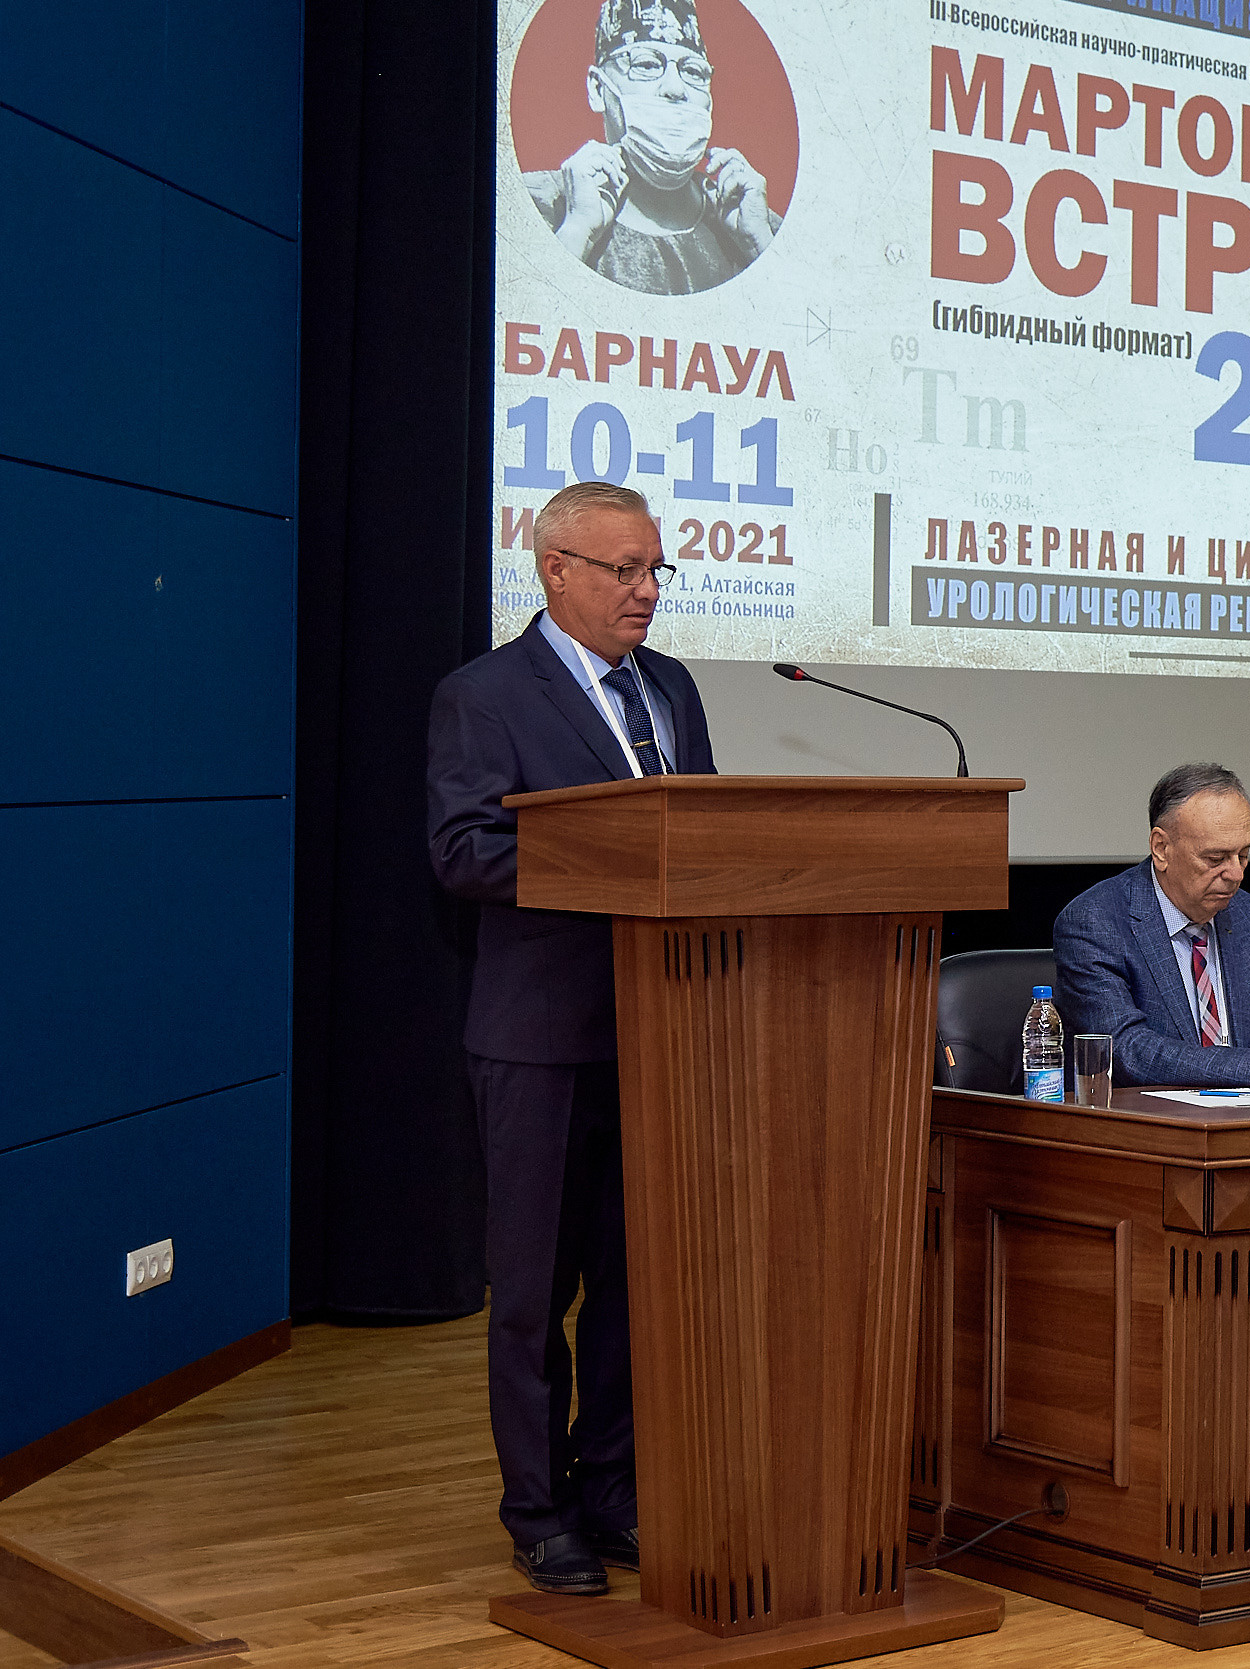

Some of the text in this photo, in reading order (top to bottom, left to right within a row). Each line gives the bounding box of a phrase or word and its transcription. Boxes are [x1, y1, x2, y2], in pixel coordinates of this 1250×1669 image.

[950, 3, 1078, 47] Всероссийская
[1081, 31, 1247, 79] научно-практическая
[889, 334, 920, 362] 69
[932, 299, 1193, 360] (гибридный формат)
[504, 322, 796, 402] БАРНАУЛ
[804, 407, 821, 423] 67
[902, 366, 1030, 453] Tm
[503, 395, 794, 507] 10-11
[824, 425, 888, 475] Ho
[677, 518, 794, 566] 2021
[924, 517, 1145, 574] ЛАЗЕРНАЯ
[1167, 535, 1185, 576] И
[499, 568, 523, 587] ул.
[701, 573, 795, 597] Алтайская
[500, 590, 795, 621] крае еская больница
[927, 577, 1201, 631] УРОЛОГИЧЕСКАЯ
